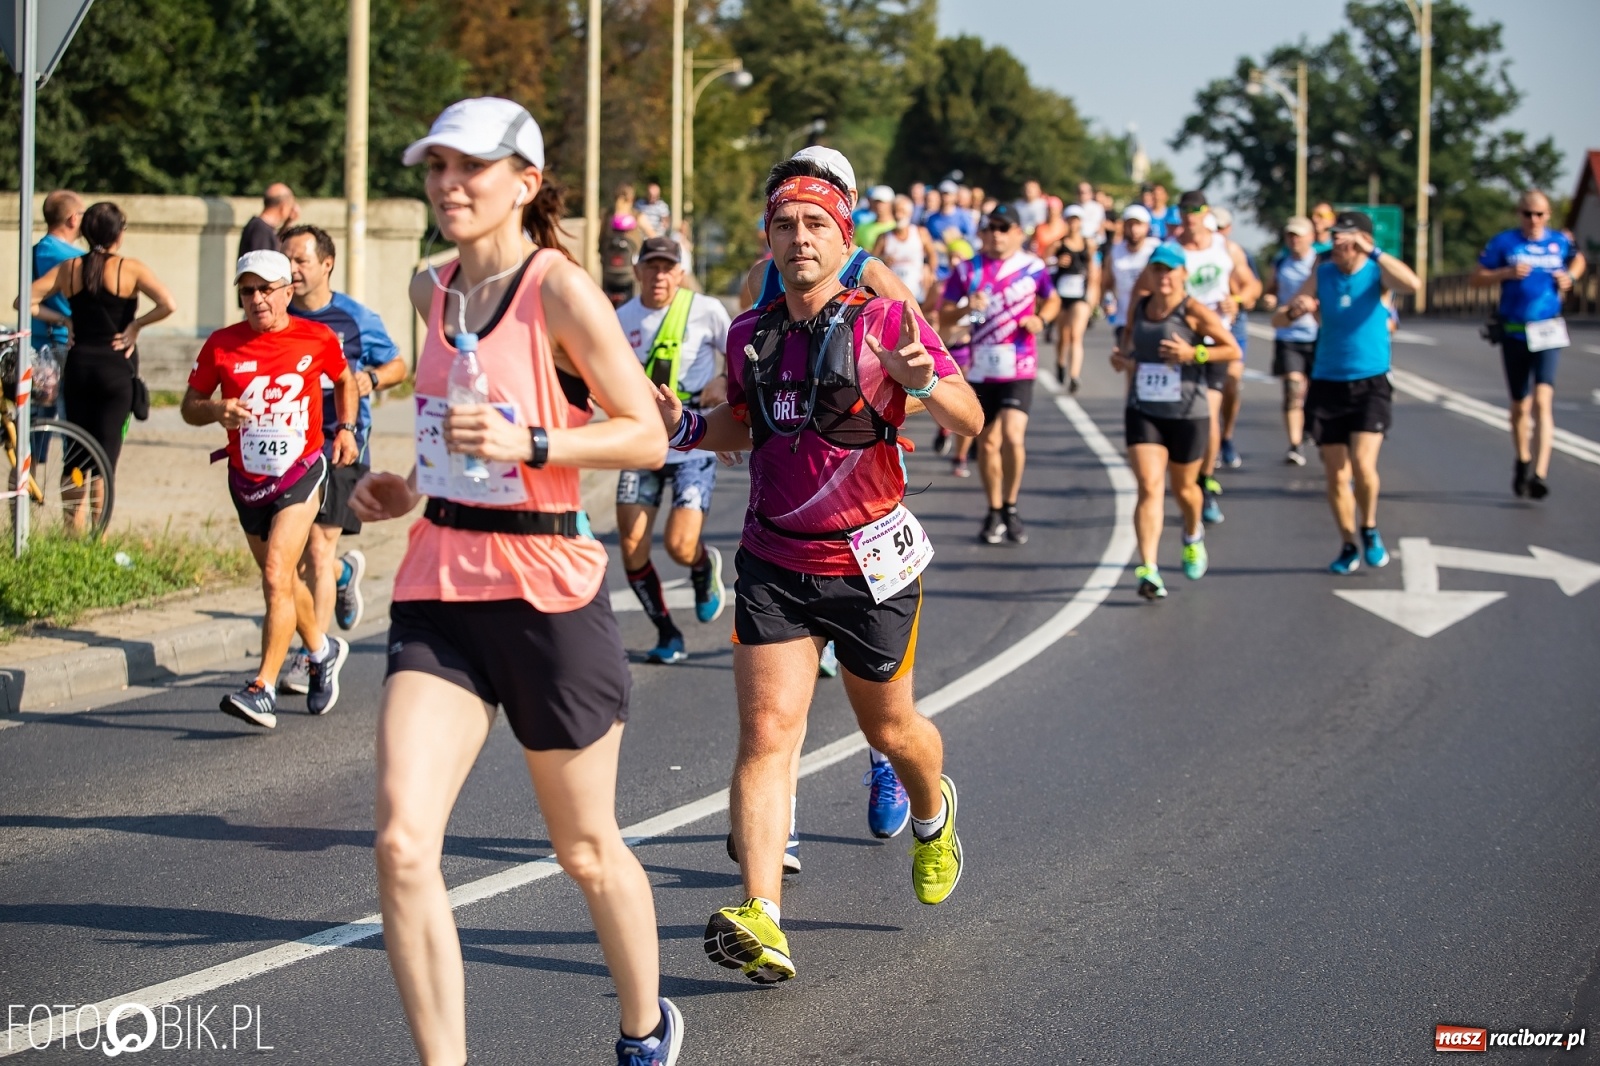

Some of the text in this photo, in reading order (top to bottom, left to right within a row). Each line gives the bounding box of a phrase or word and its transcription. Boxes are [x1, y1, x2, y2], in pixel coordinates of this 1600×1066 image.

[258, 440, 288, 456] 243
[892, 524, 914, 556] 50
[877, 661, 897, 672] 4F
